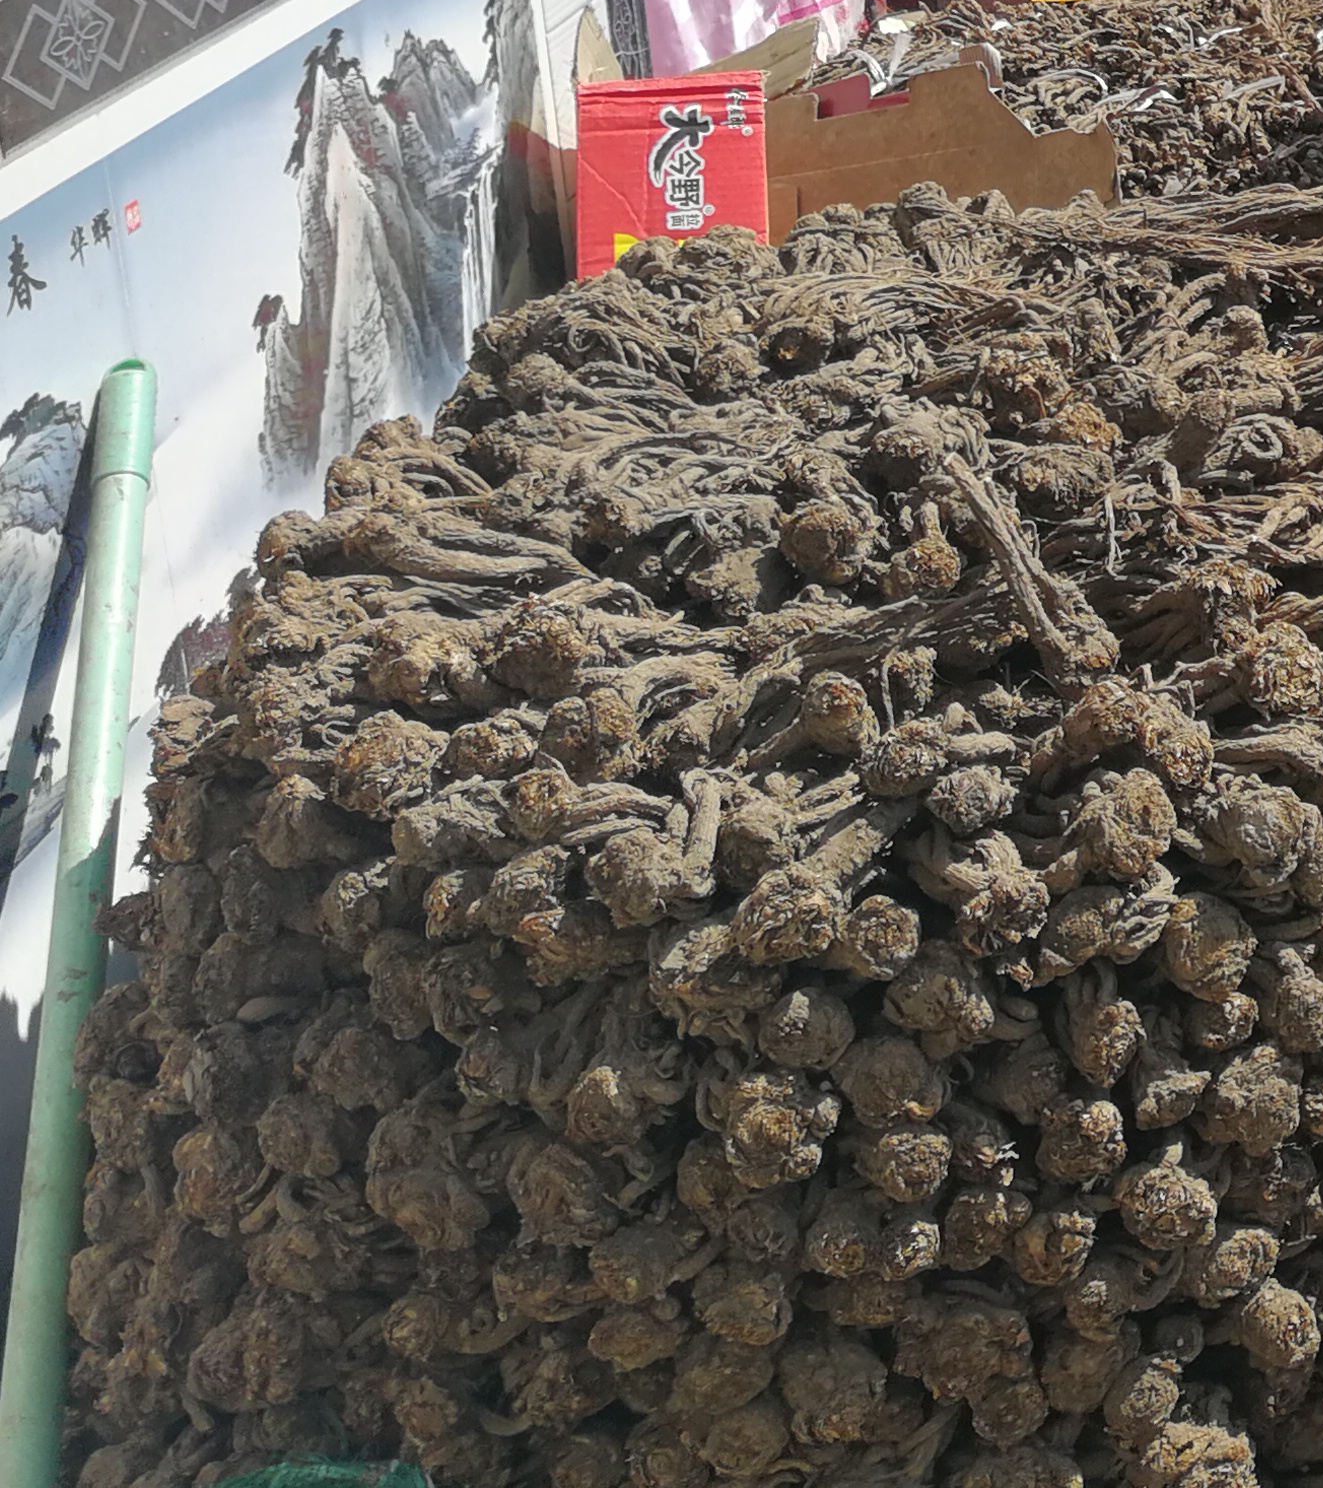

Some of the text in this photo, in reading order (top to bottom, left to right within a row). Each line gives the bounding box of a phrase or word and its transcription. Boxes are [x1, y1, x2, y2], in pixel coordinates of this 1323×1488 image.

[650, 104, 713, 228] 大今野 拉面
[7, 234, 47, 317] 春
